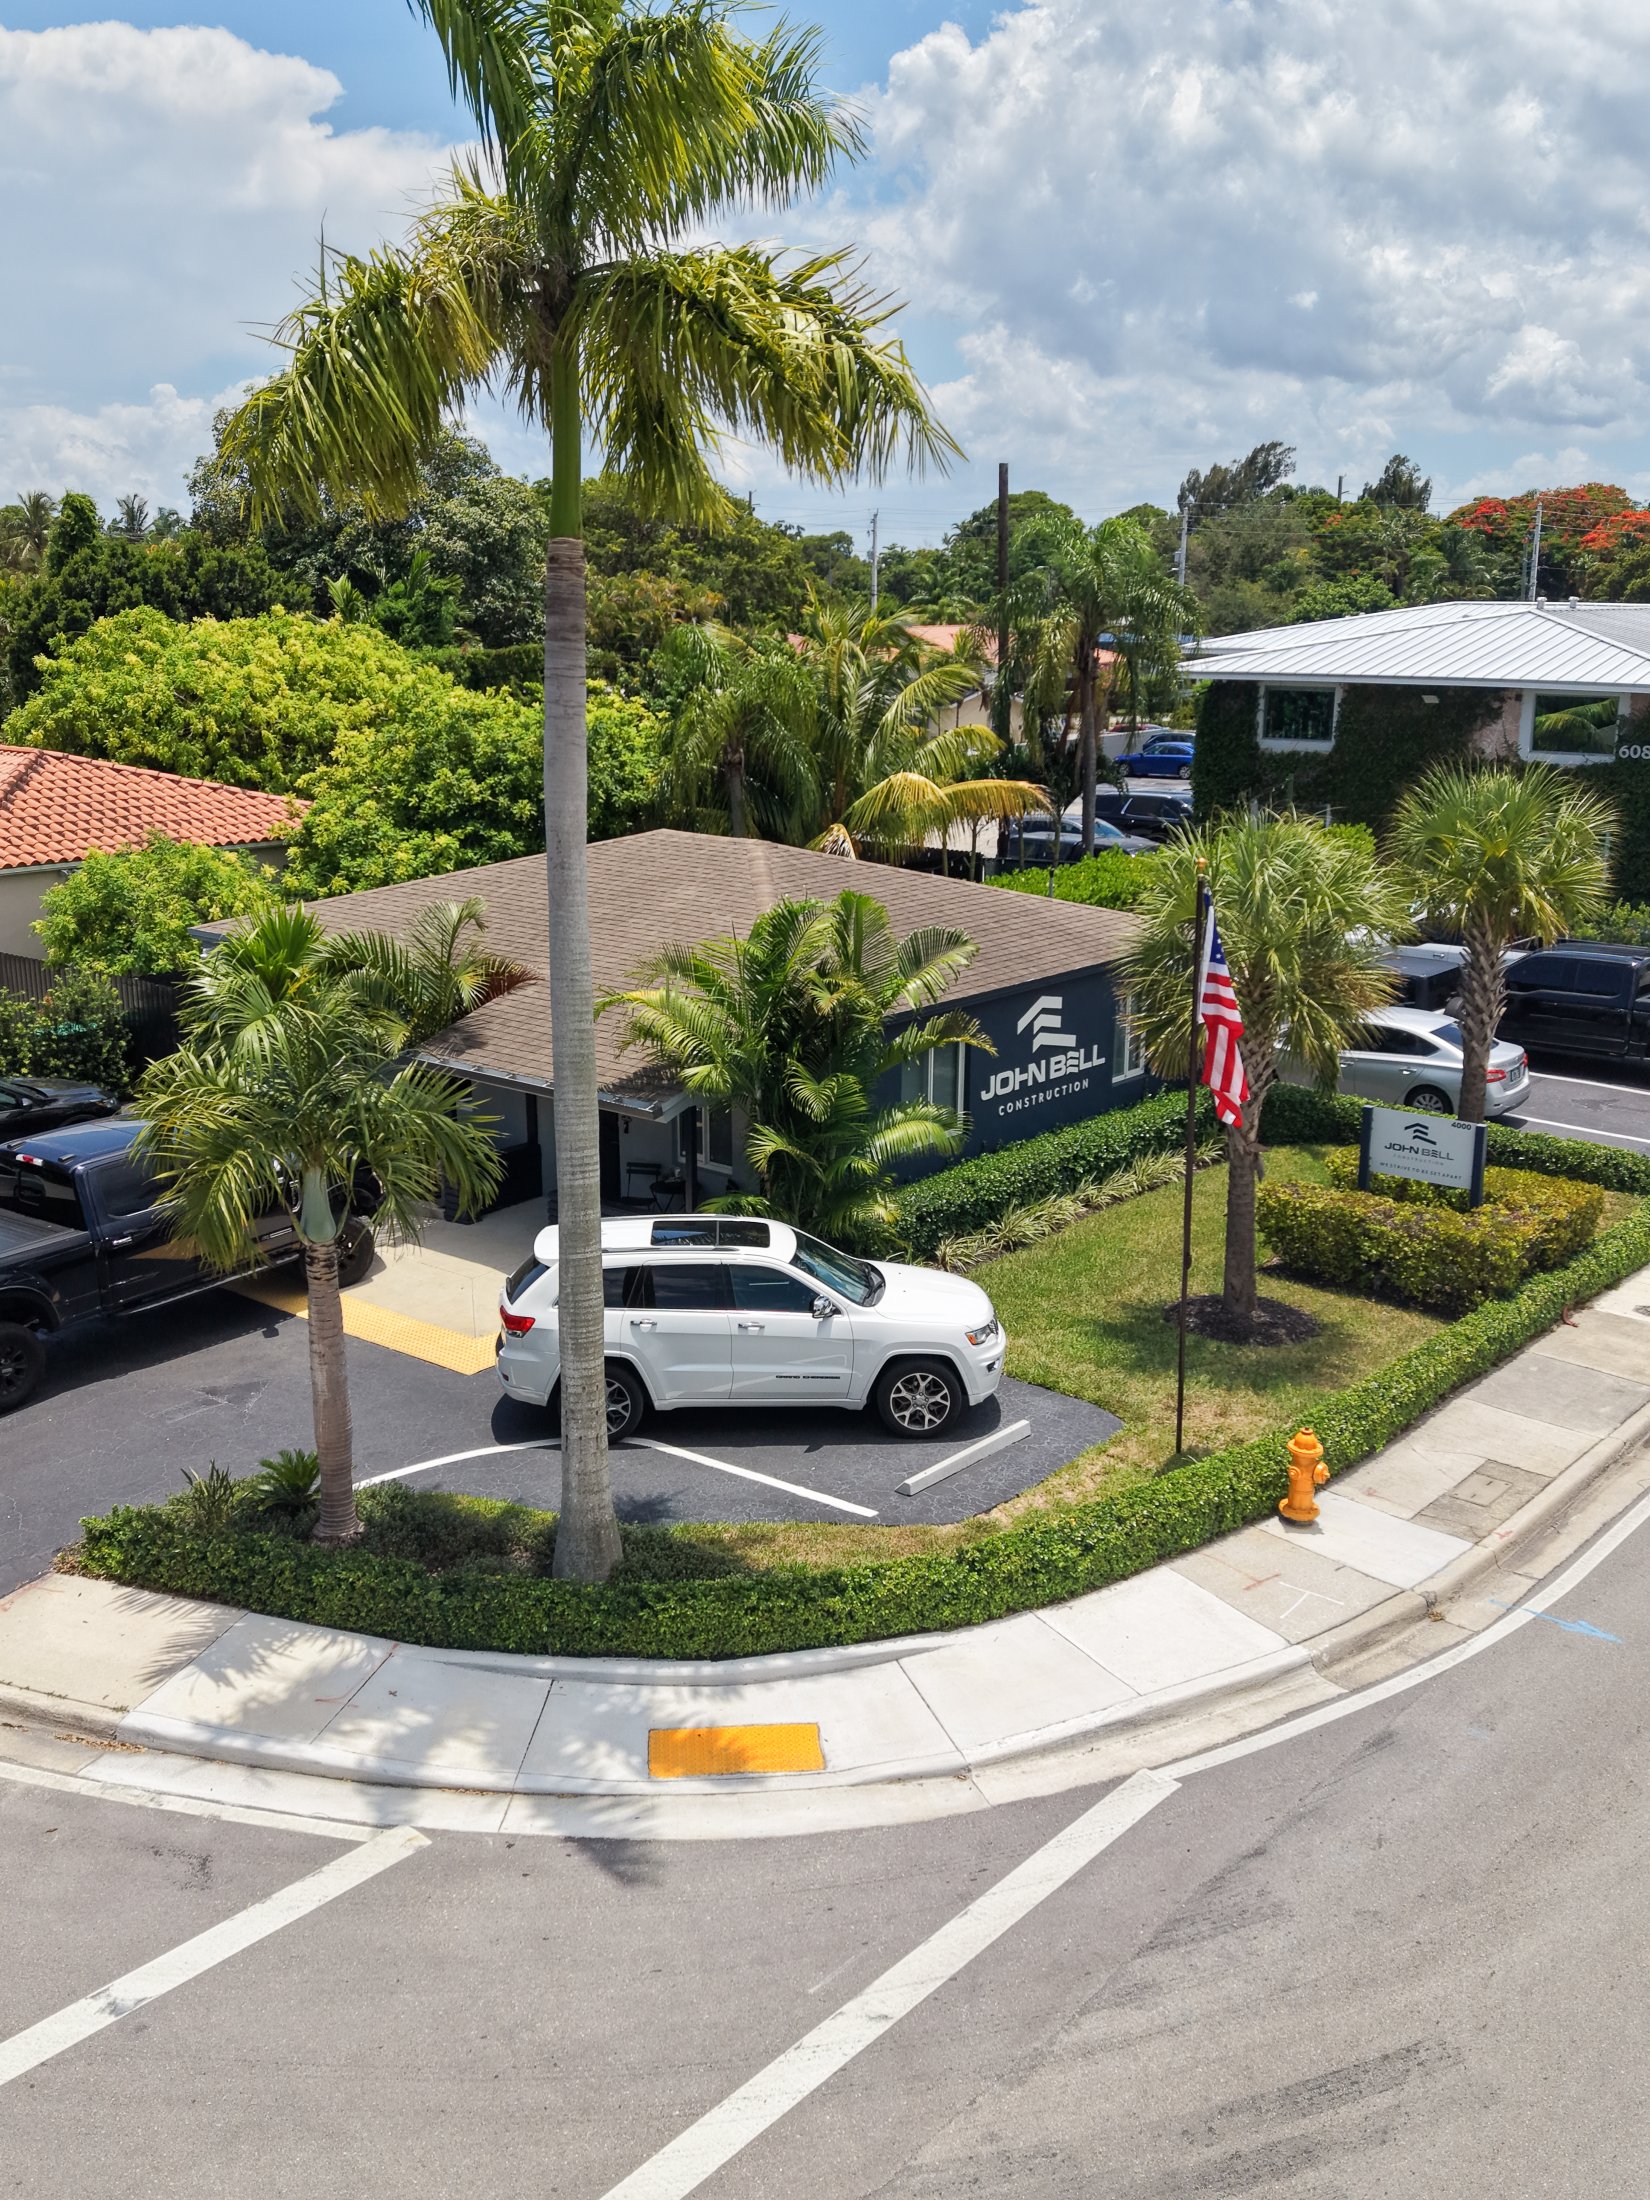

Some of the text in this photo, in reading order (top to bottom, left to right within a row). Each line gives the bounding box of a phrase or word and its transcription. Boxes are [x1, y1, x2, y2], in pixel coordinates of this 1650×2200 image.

[980, 1044, 1106, 1101] JOHN BELL
[999, 1078, 1089, 1116] CONSTRUCTION
[1451, 1121, 1472, 1131] 4000
[1384, 1142, 1454, 1161] JOHN BELL
